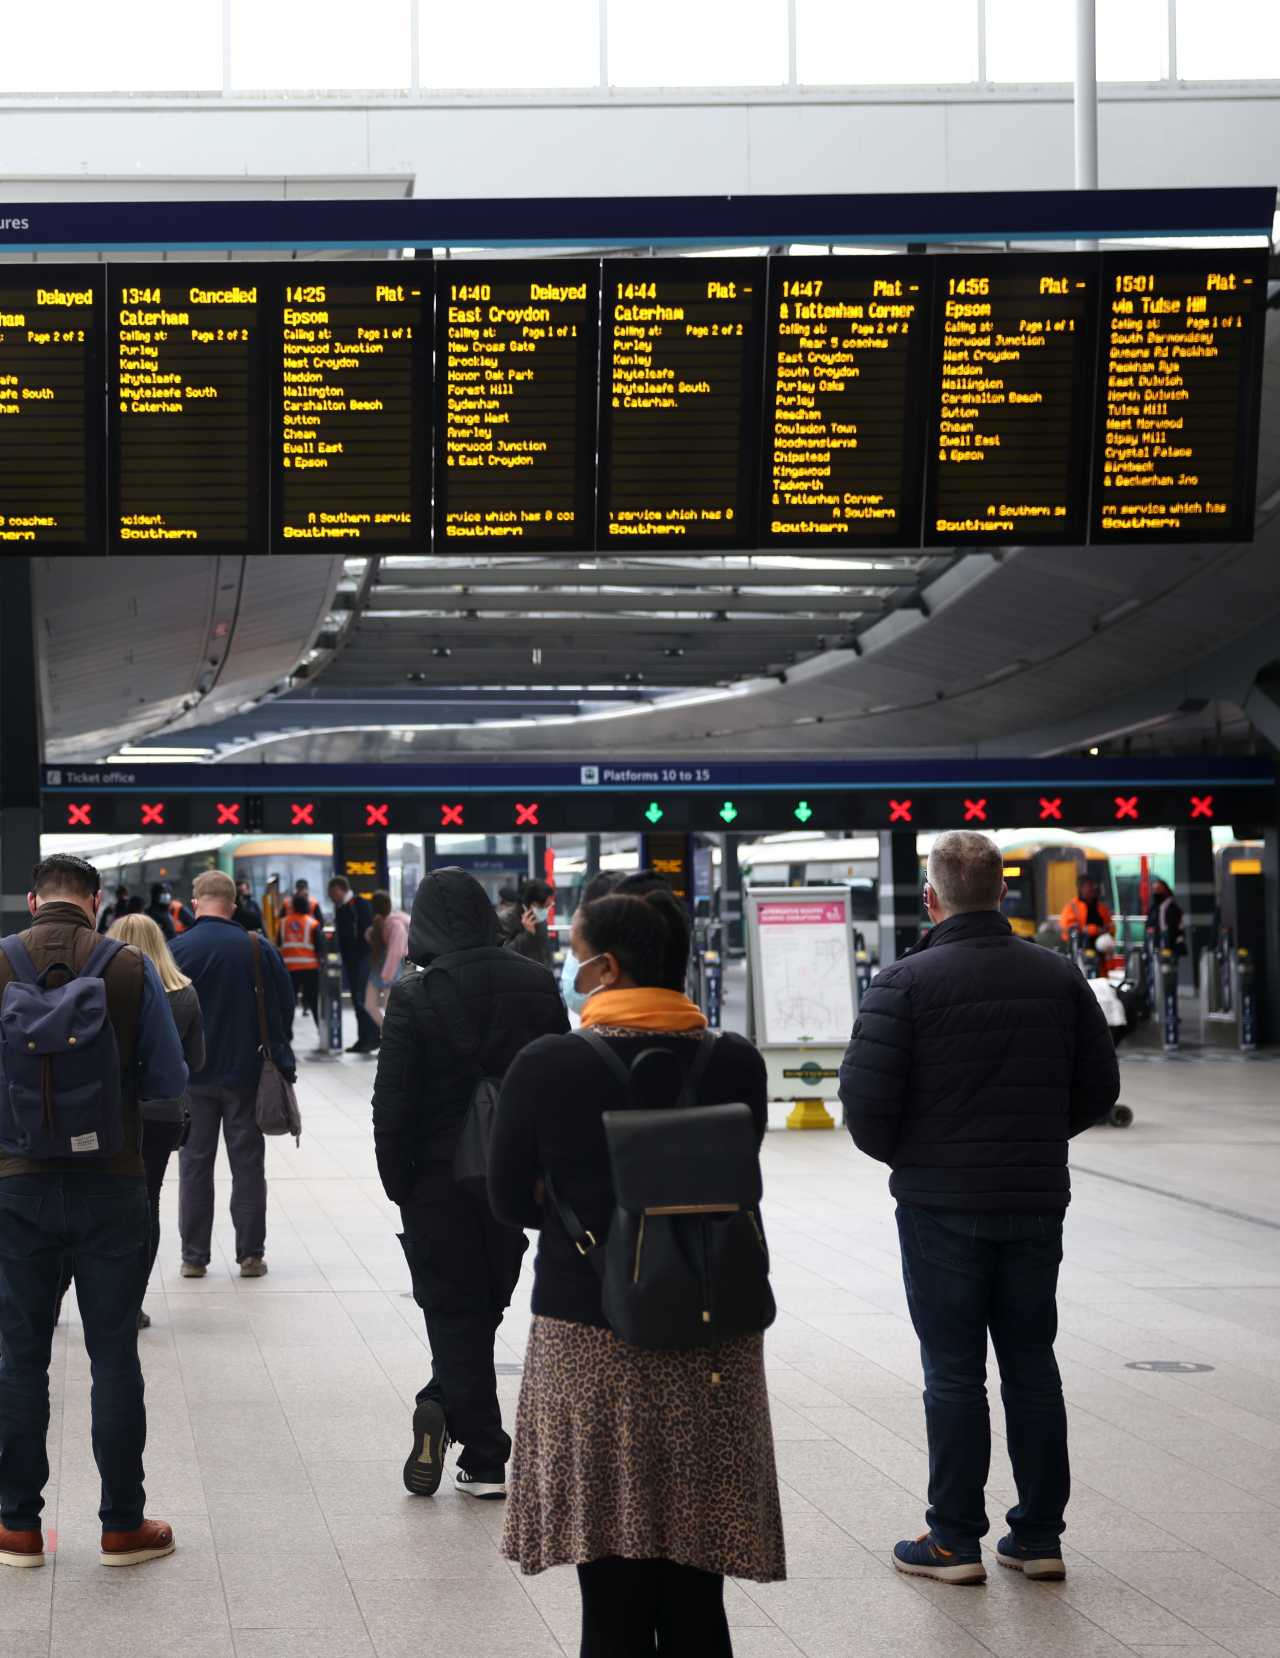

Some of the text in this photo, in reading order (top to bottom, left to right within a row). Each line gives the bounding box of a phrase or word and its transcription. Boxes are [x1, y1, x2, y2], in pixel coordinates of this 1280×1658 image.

[618, 282, 736, 299] 14:44 Plat
[784, 280, 902, 296] 14:47 Plat
[1040, 277, 1069, 294] Plat
[1116, 273, 1236, 292] 15:01 Plat
[37, 289, 92, 305] Delayed
[122, 288, 257, 304] 13:44 Cancelled
[286, 286, 405, 302] 14:25 Plat
[451, 284, 586, 301] 14:40 Delayed
[615, 305, 684, 320] Caterham
[945, 301, 991, 318] Epsom
[1112, 296, 1206, 314] via Tulse Hill
[120, 310, 189, 325] Caterham
[284, 308, 328, 326] Epsom
[449, 306, 550, 323] East Croydon
[446, 525, 523, 536] Southern
[609, 524, 685, 534] Southern
[771, 521, 848, 532] Southern
[936, 520, 1013, 531] Southern
[1102, 517, 1180, 528] Southern
[120, 528, 197, 539] Southern
[283, 527, 360, 537] Southern
[67, 772, 135, 783] Ticket office
[603, 769, 710, 781] Platforms 10 to 15
